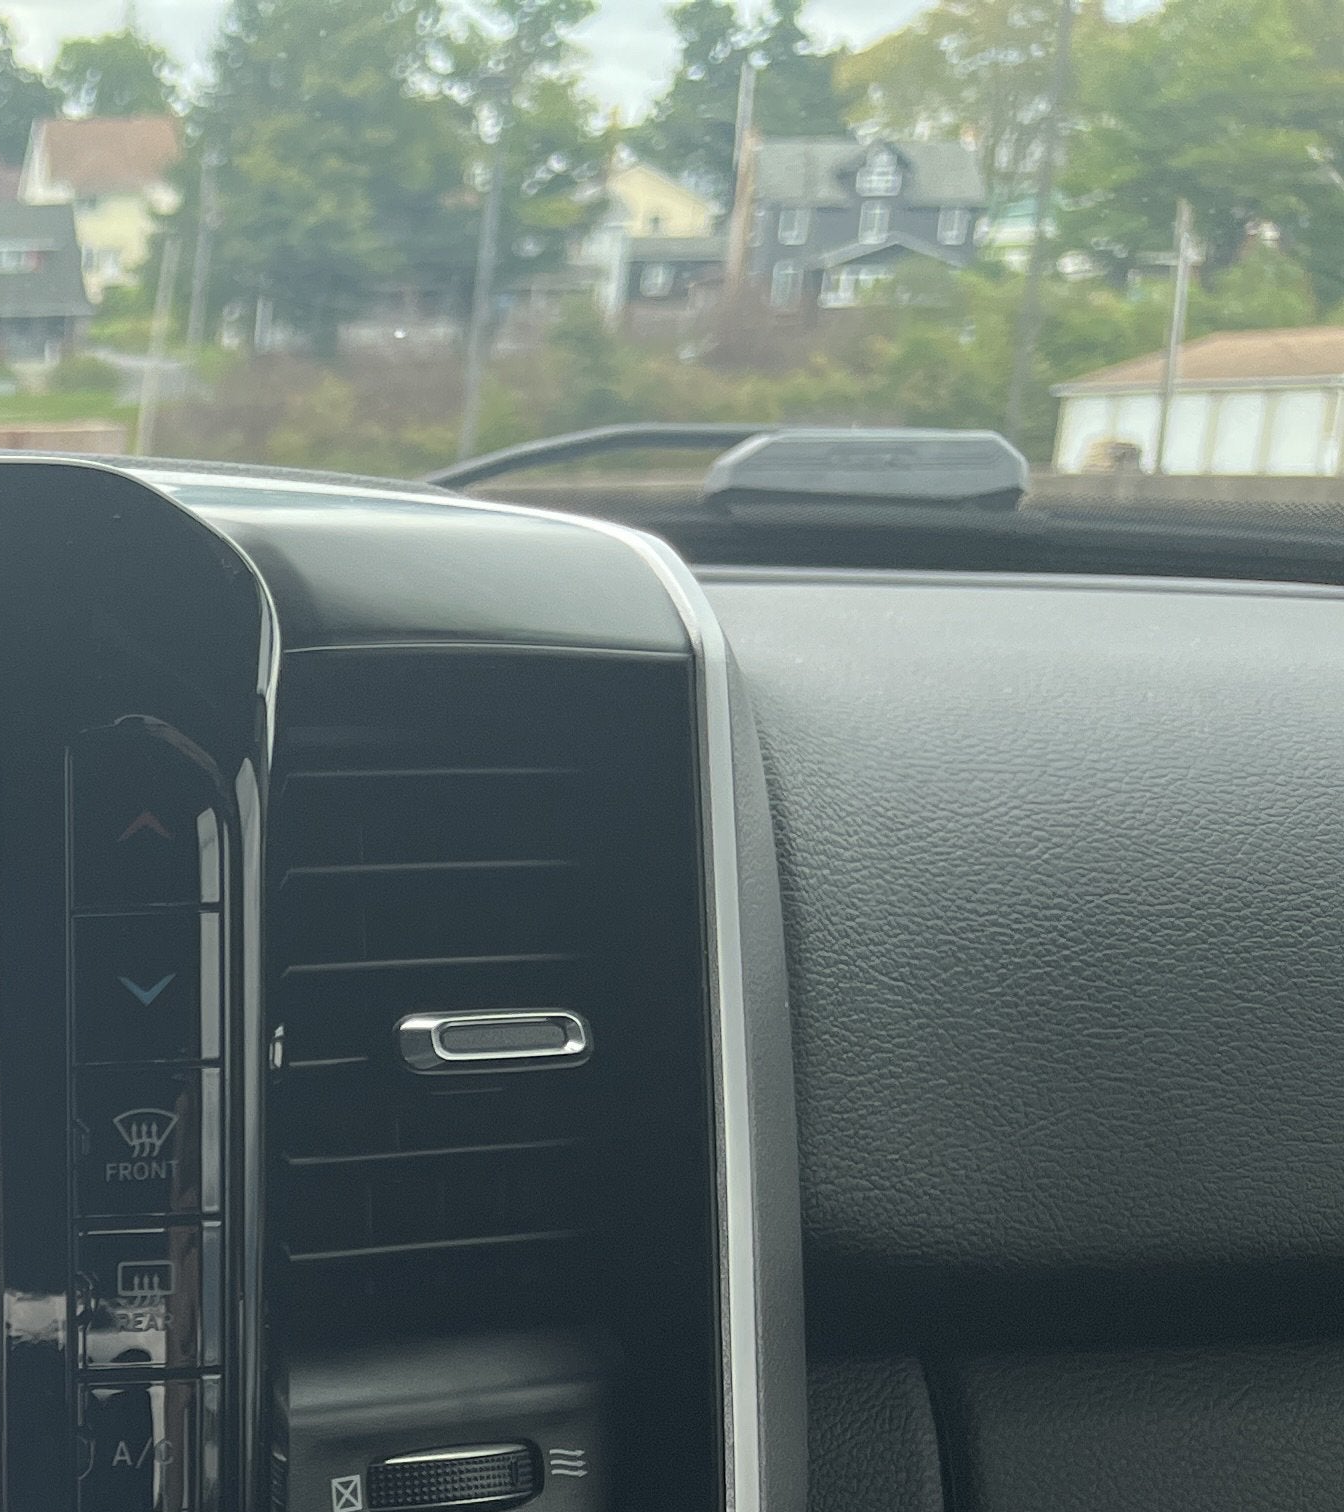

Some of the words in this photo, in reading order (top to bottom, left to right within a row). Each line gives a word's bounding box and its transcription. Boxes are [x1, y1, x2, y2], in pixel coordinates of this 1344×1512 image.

[105, 1161, 178, 1182] FRONT
[117, 1313, 172, 1332] REAR
[113, 1439, 174, 1468] A/C
